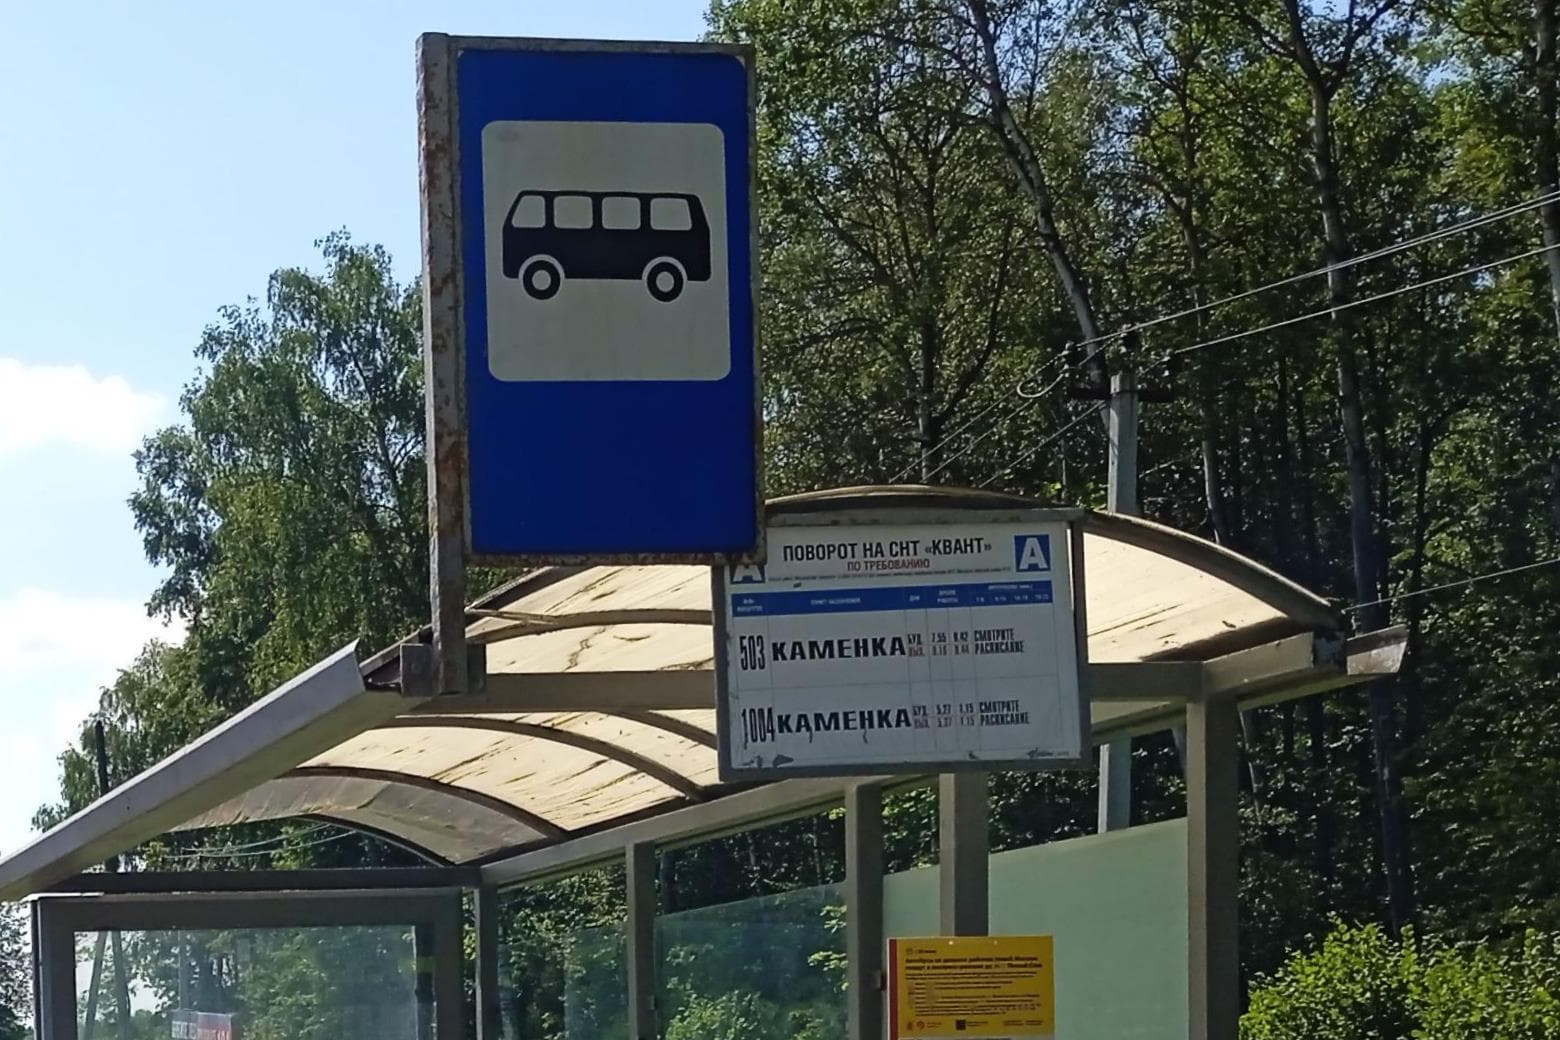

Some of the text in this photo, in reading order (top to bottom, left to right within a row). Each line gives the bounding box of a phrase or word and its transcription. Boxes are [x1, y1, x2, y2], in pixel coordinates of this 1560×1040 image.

[783, 537, 992, 563] ПОВОРОТ НА СНТ «КВАНТ»
[847, 558, 930, 571] ПО ТРЕБОВАНИЮ
[740, 635, 766, 671] 503
[772, 636, 906, 661] КАМЕНКА
[742, 707, 776, 744] 1004
[778, 708, 912, 733] КАМЕНКА
